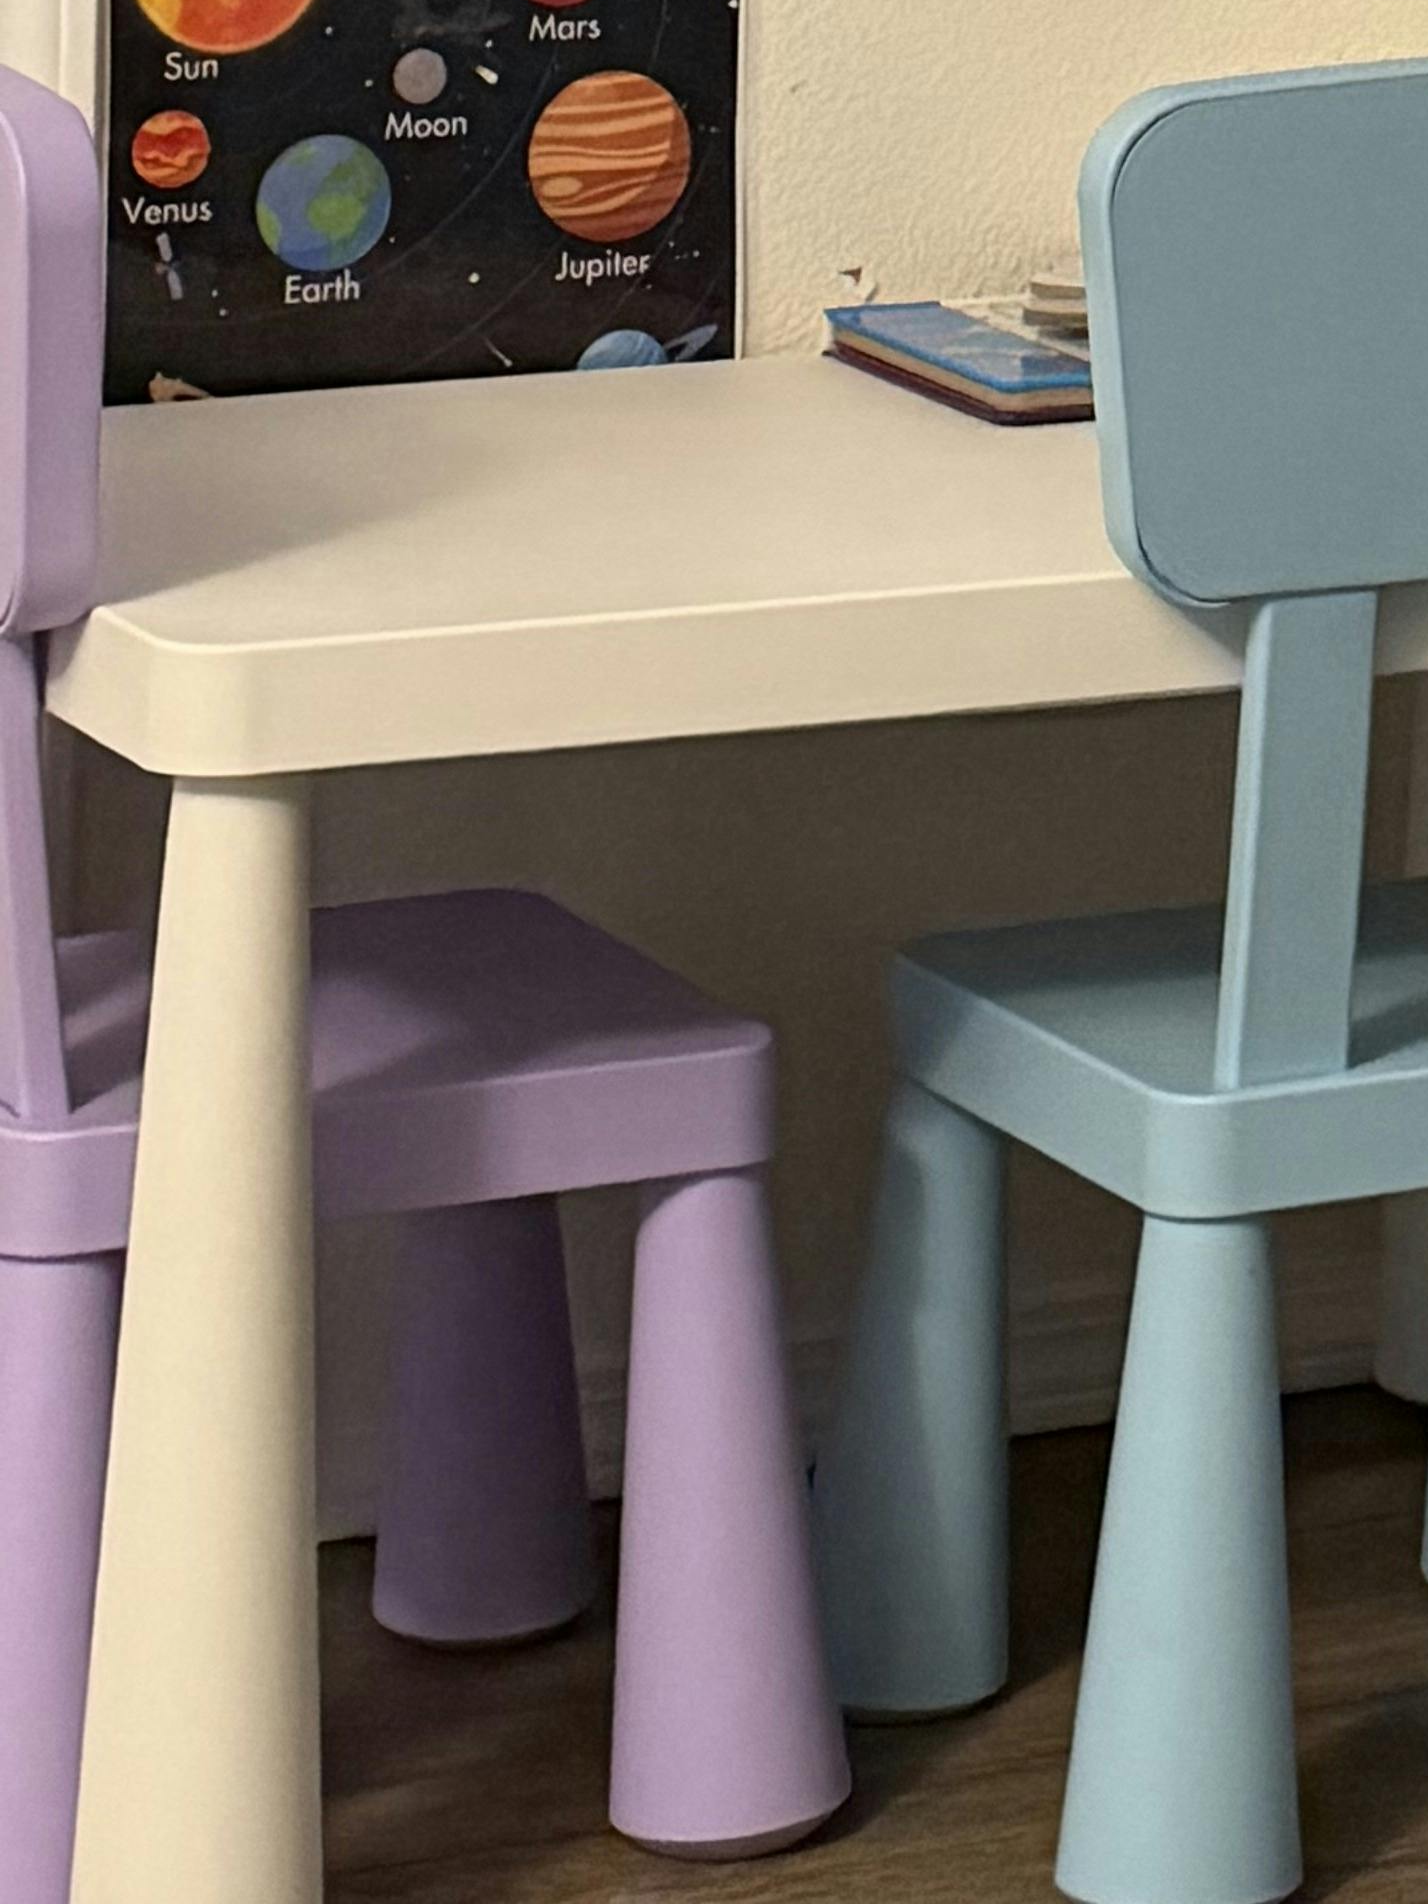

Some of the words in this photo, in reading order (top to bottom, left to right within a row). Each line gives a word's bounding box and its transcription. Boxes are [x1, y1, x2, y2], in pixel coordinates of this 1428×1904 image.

[528, 13, 602, 42] Mars
[163, 52, 219, 81] Sun
[383, 112, 468, 140] Moon
[121, 197, 213, 226] Venus
[554, 250, 650, 286] Jupiter
[283, 274, 361, 305] Earth
